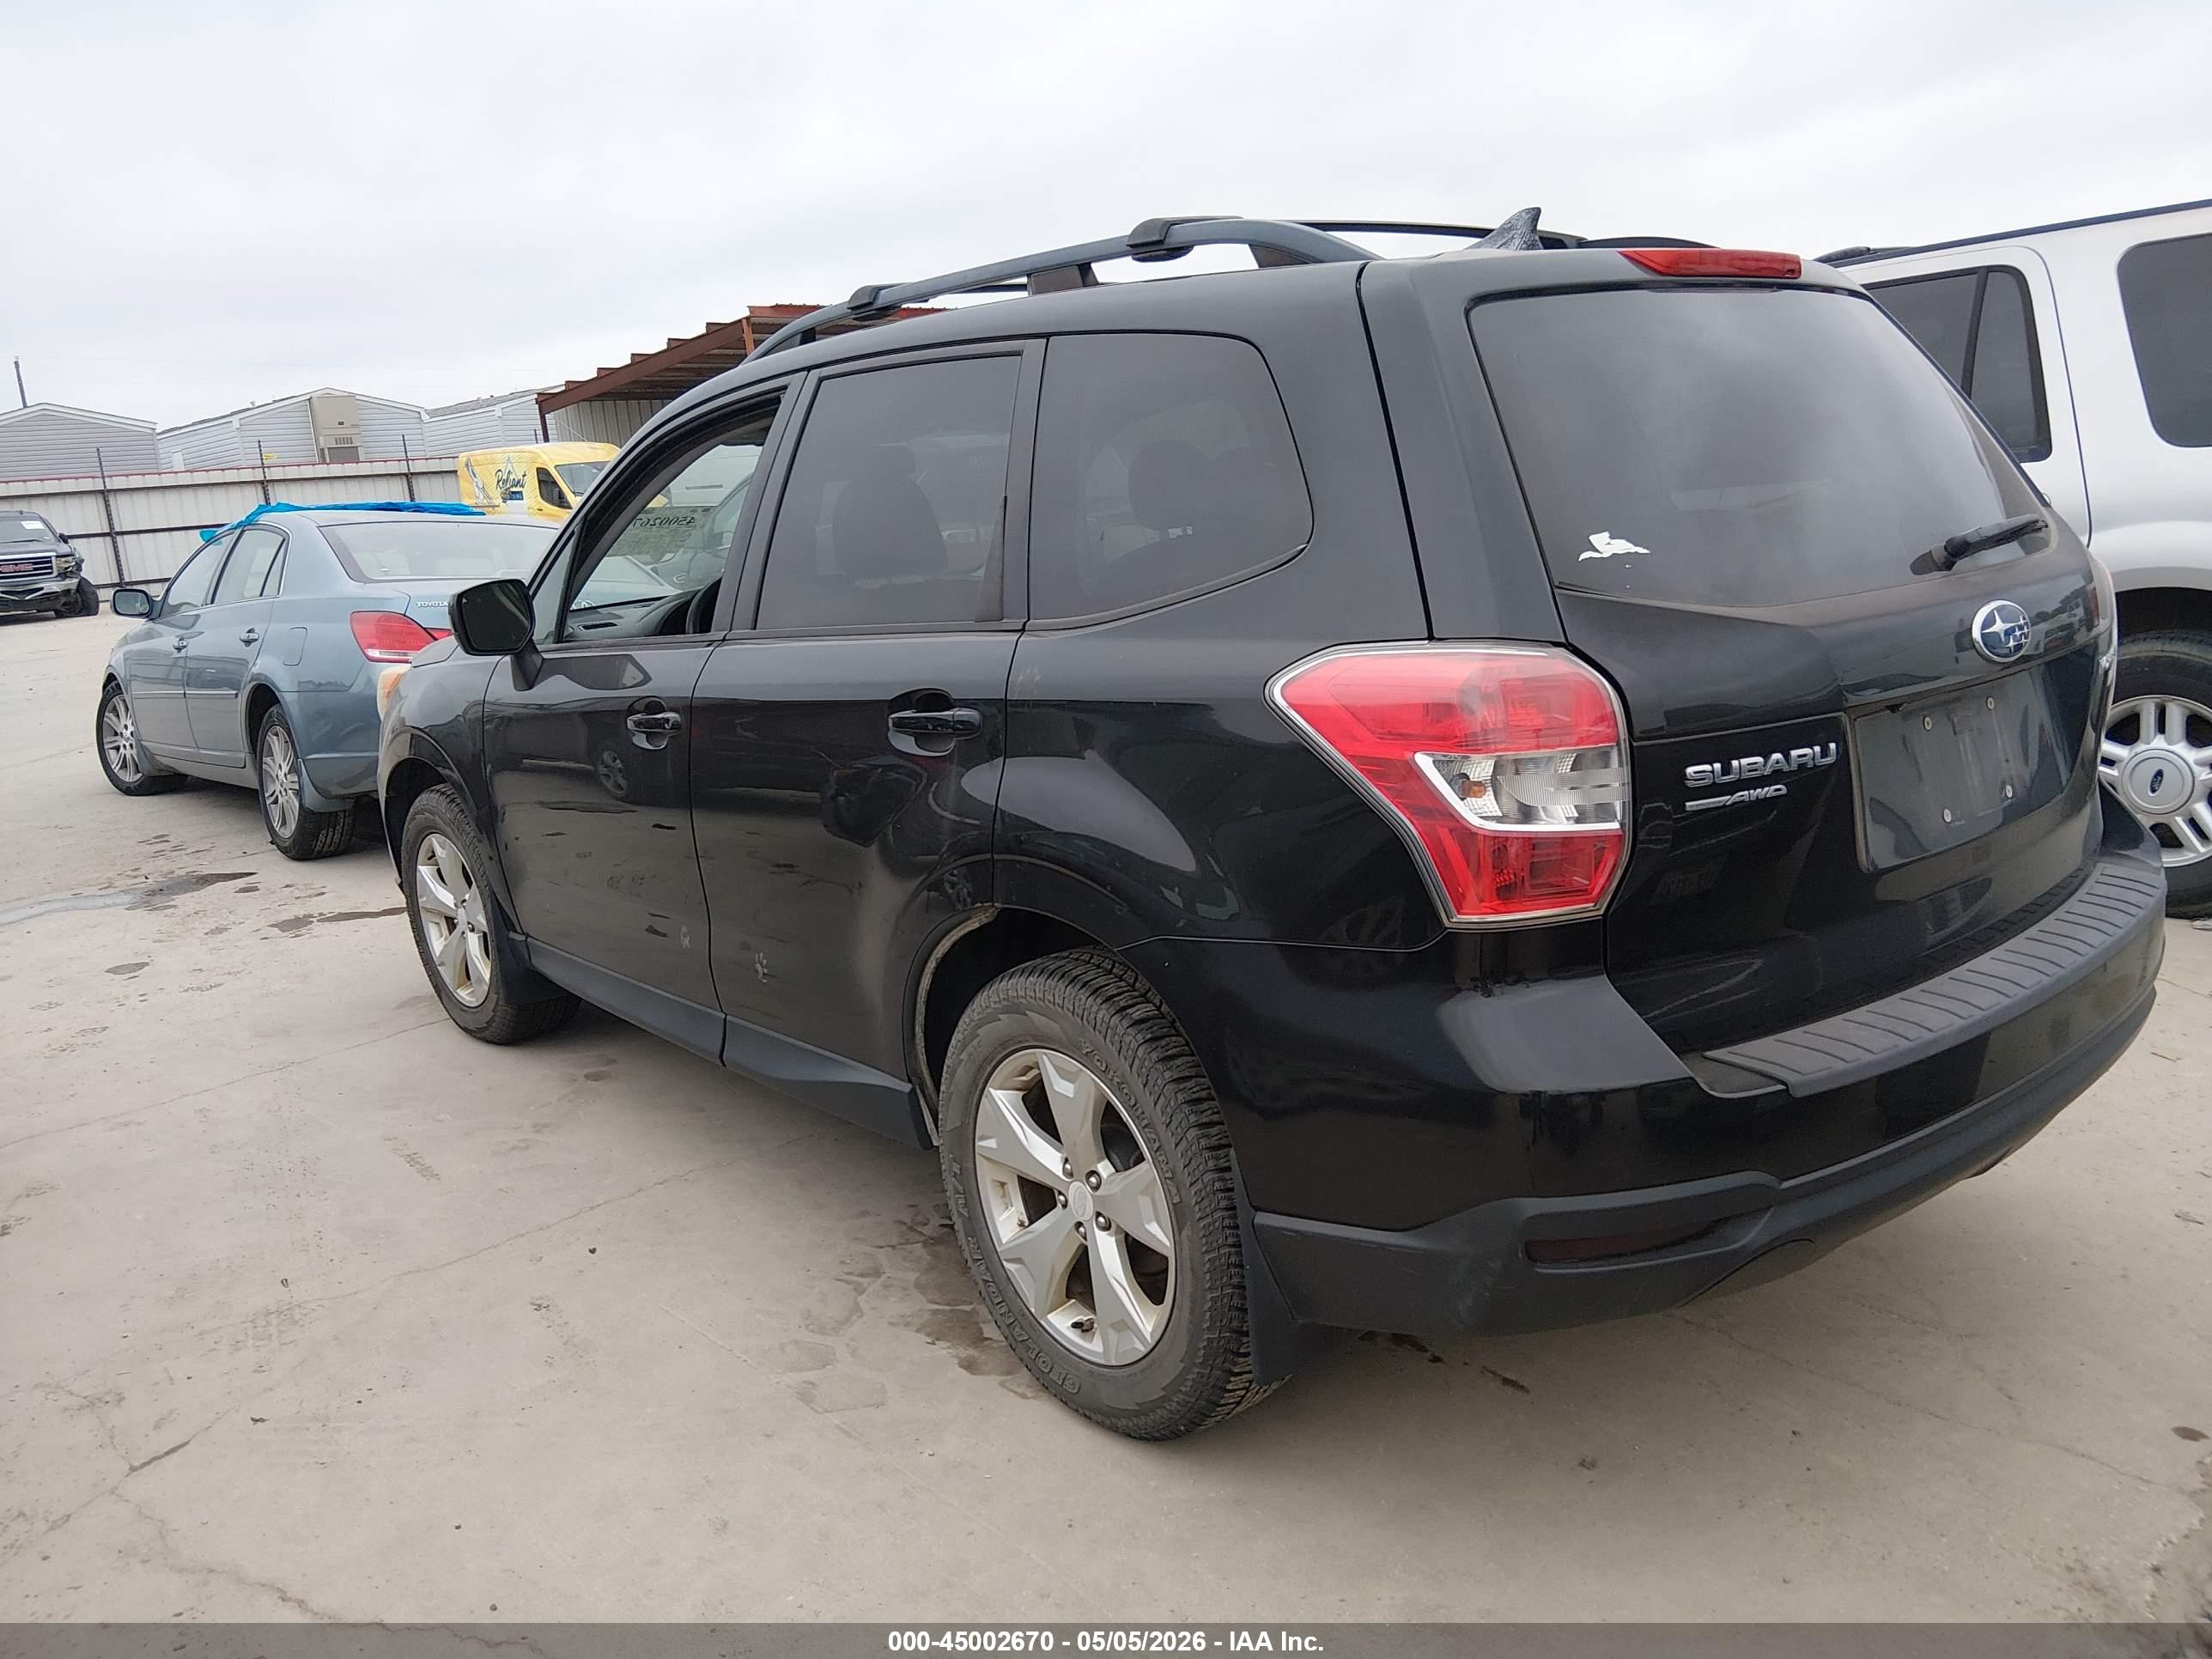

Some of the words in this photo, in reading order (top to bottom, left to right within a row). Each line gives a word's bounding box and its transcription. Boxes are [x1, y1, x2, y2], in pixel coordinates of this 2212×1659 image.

[495, 469, 527, 490] Reliant
[1685, 743, 1837, 788] SUBARU
[1725, 784, 1788, 805] AWD
[1079, 1035, 1182, 1204] YOKOHAMA
[967, 1237, 1082, 1395] GEOLANDAR
